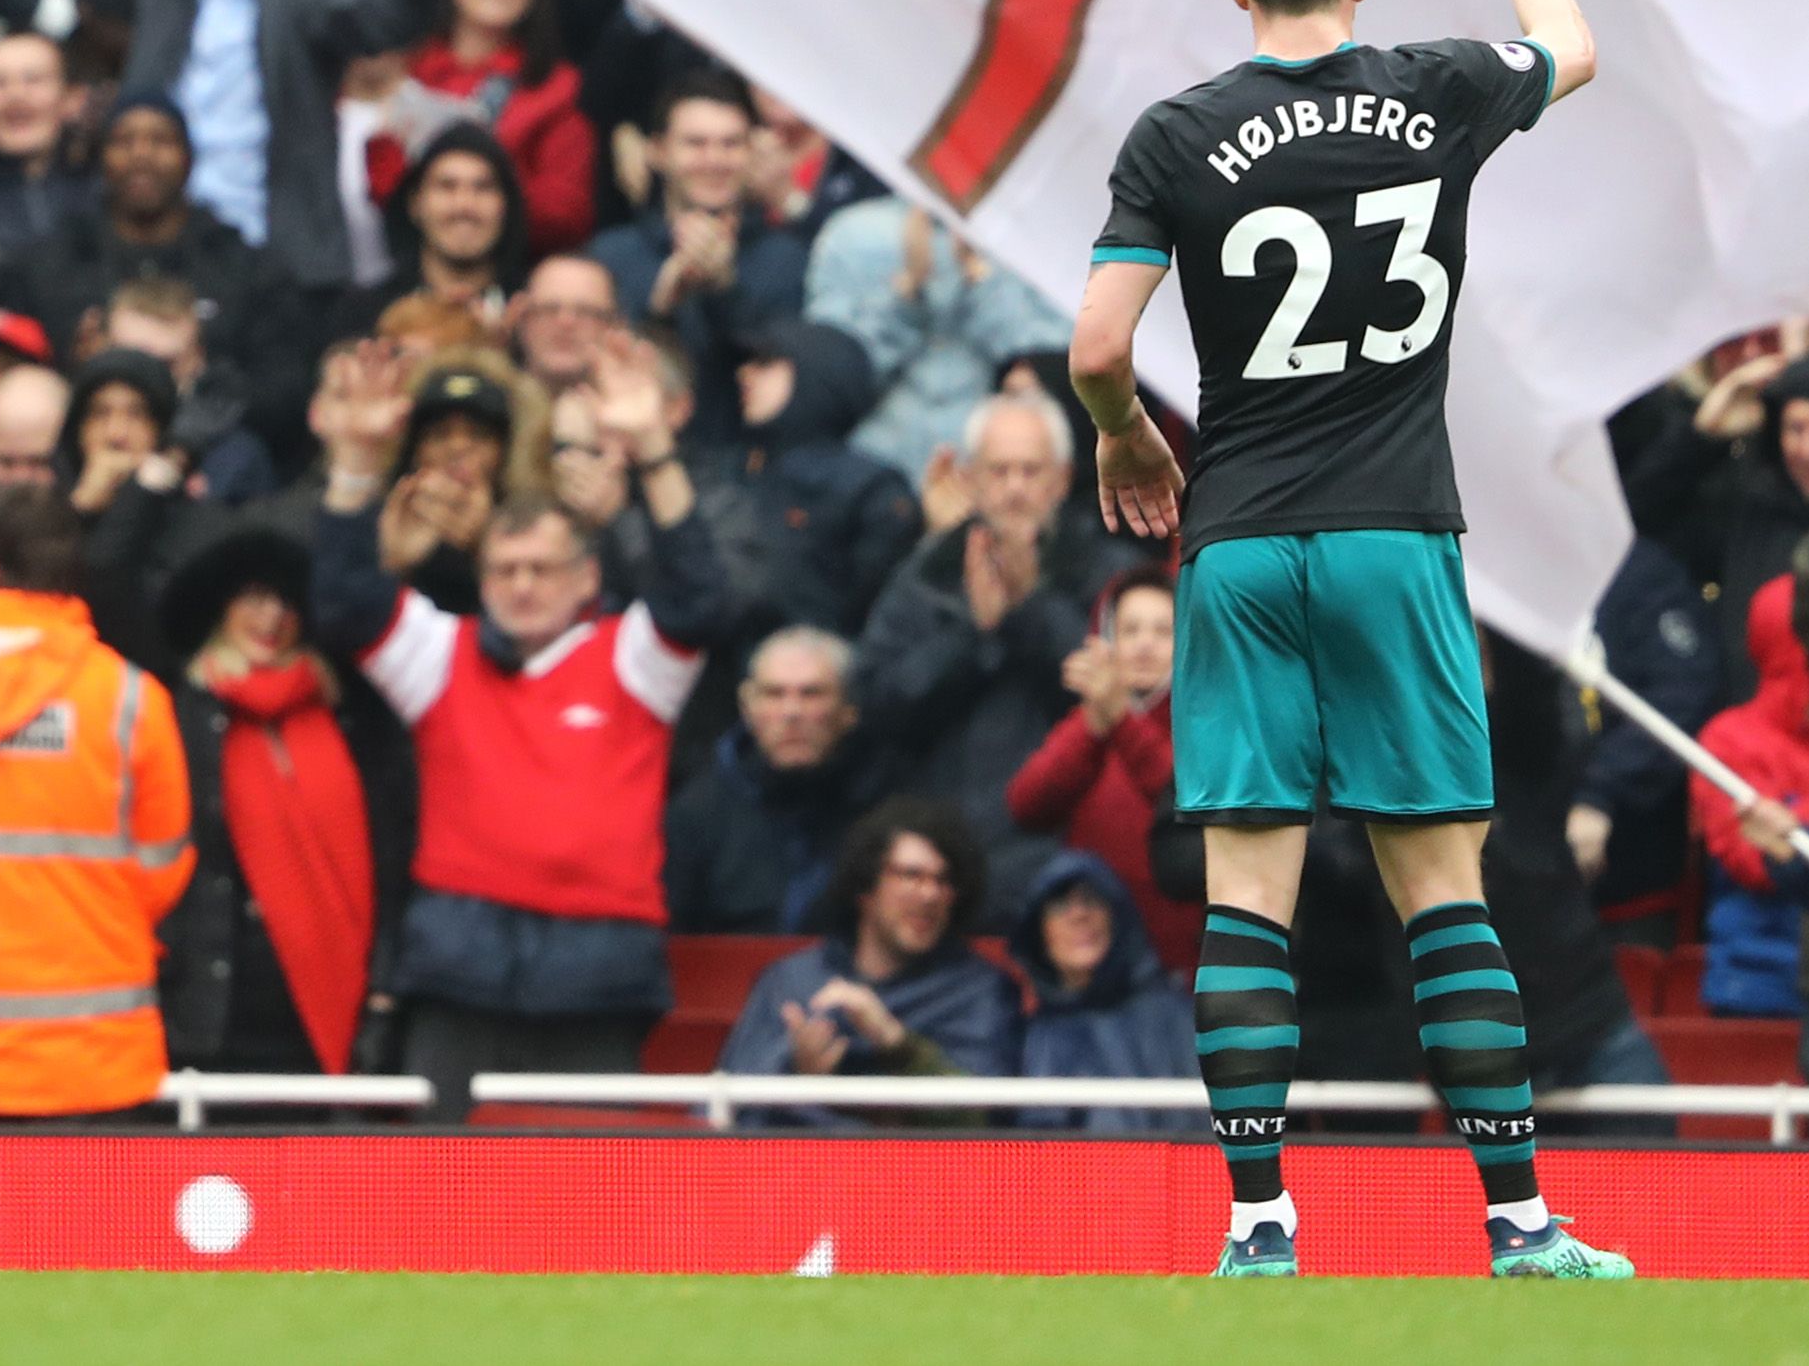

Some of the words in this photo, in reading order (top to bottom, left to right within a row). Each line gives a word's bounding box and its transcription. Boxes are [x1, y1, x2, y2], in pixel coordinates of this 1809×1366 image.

[1207, 93, 1437, 184] HØJBJERG
[1221, 177, 1450, 380] 23
[1210, 1115, 1287, 1136] AINT
